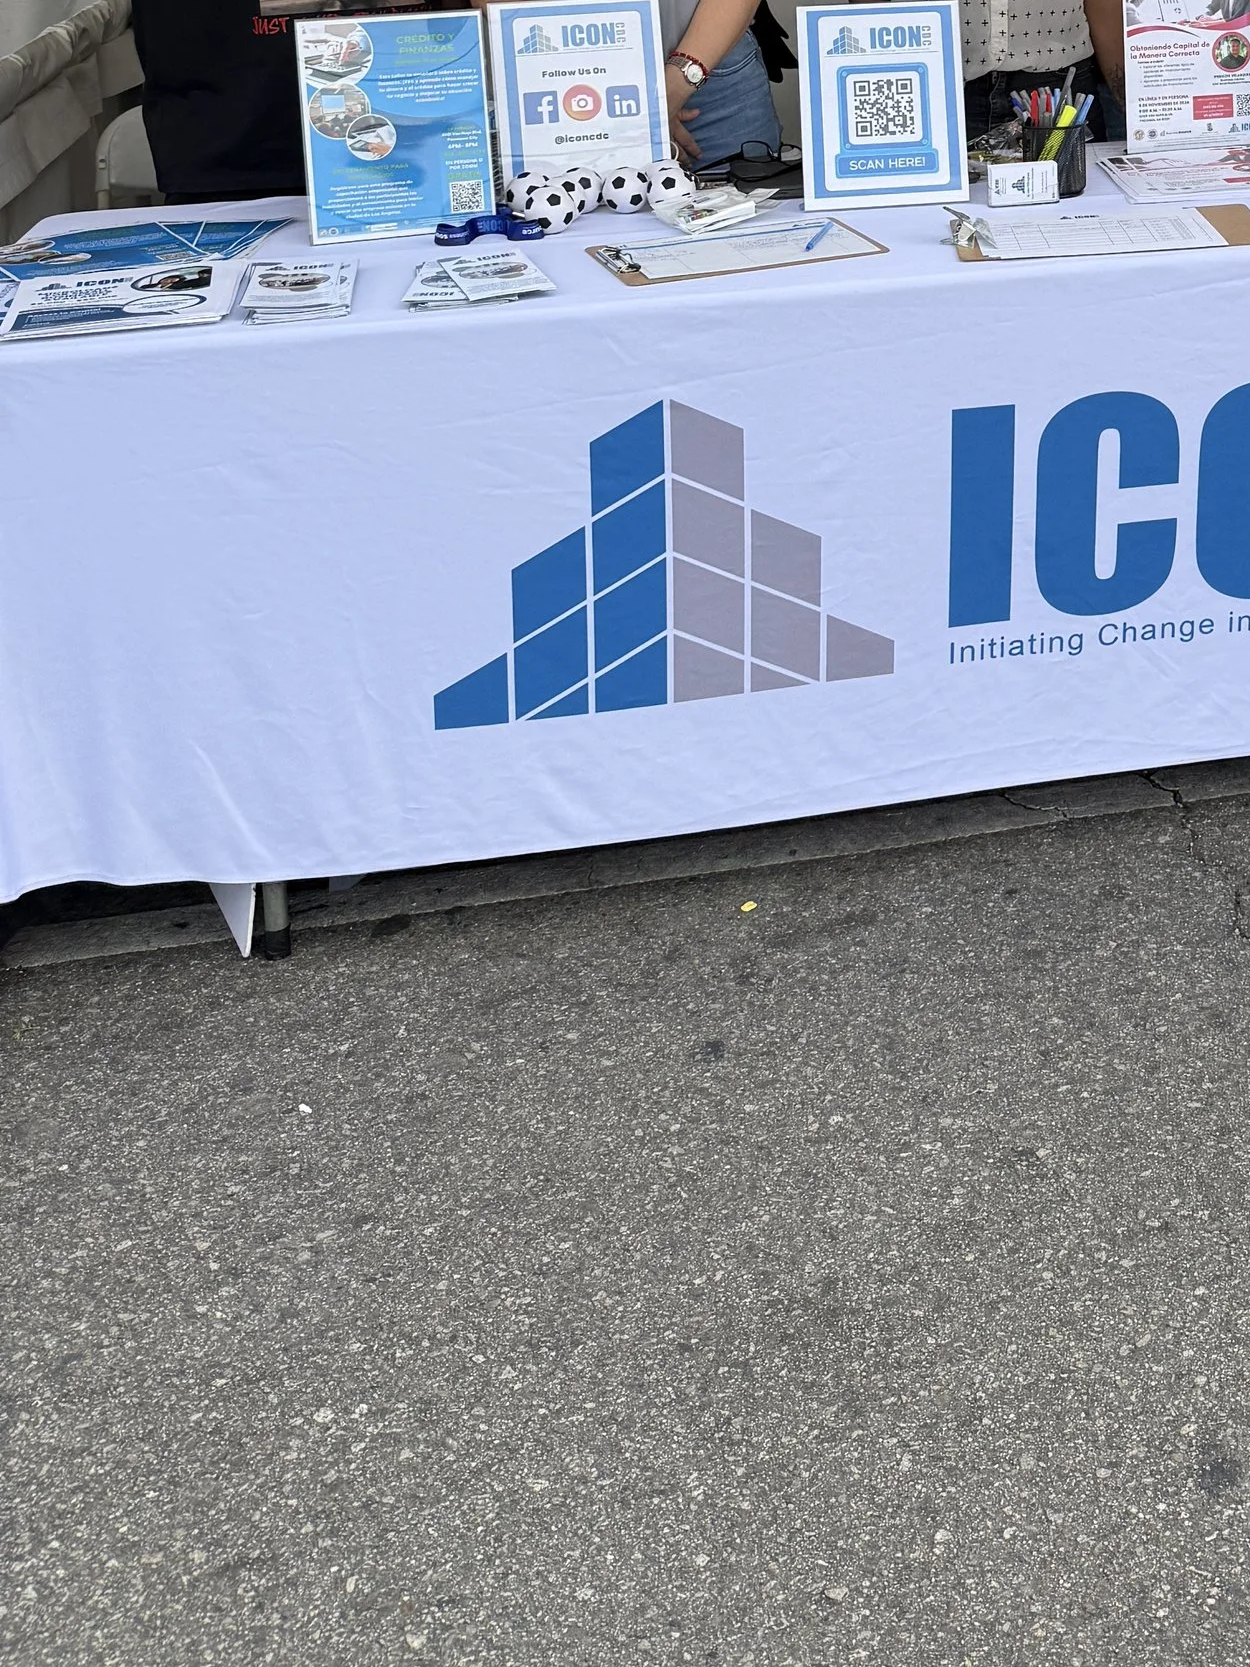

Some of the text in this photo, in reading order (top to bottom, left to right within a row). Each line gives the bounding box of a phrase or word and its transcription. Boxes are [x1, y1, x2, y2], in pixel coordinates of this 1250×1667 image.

[561, 23, 616, 47] ICON
[869, 26, 922, 49] ICON
[921, 25, 932, 46] CDC
[399, 44, 454, 54] FINANZAS
[1130, 44, 1171, 52] Obteniendo
[1173, 42, 1200, 50] Capital
[1168, 50, 1200, 58] Correcta
[542, 69, 576, 78] Follow
[555, 133, 609, 144] @iconcdc
[849, 157, 926, 171] SCAN HERE!
[948, 628, 1085, 665] Initiating
[1098, 614, 1216, 648] Change
